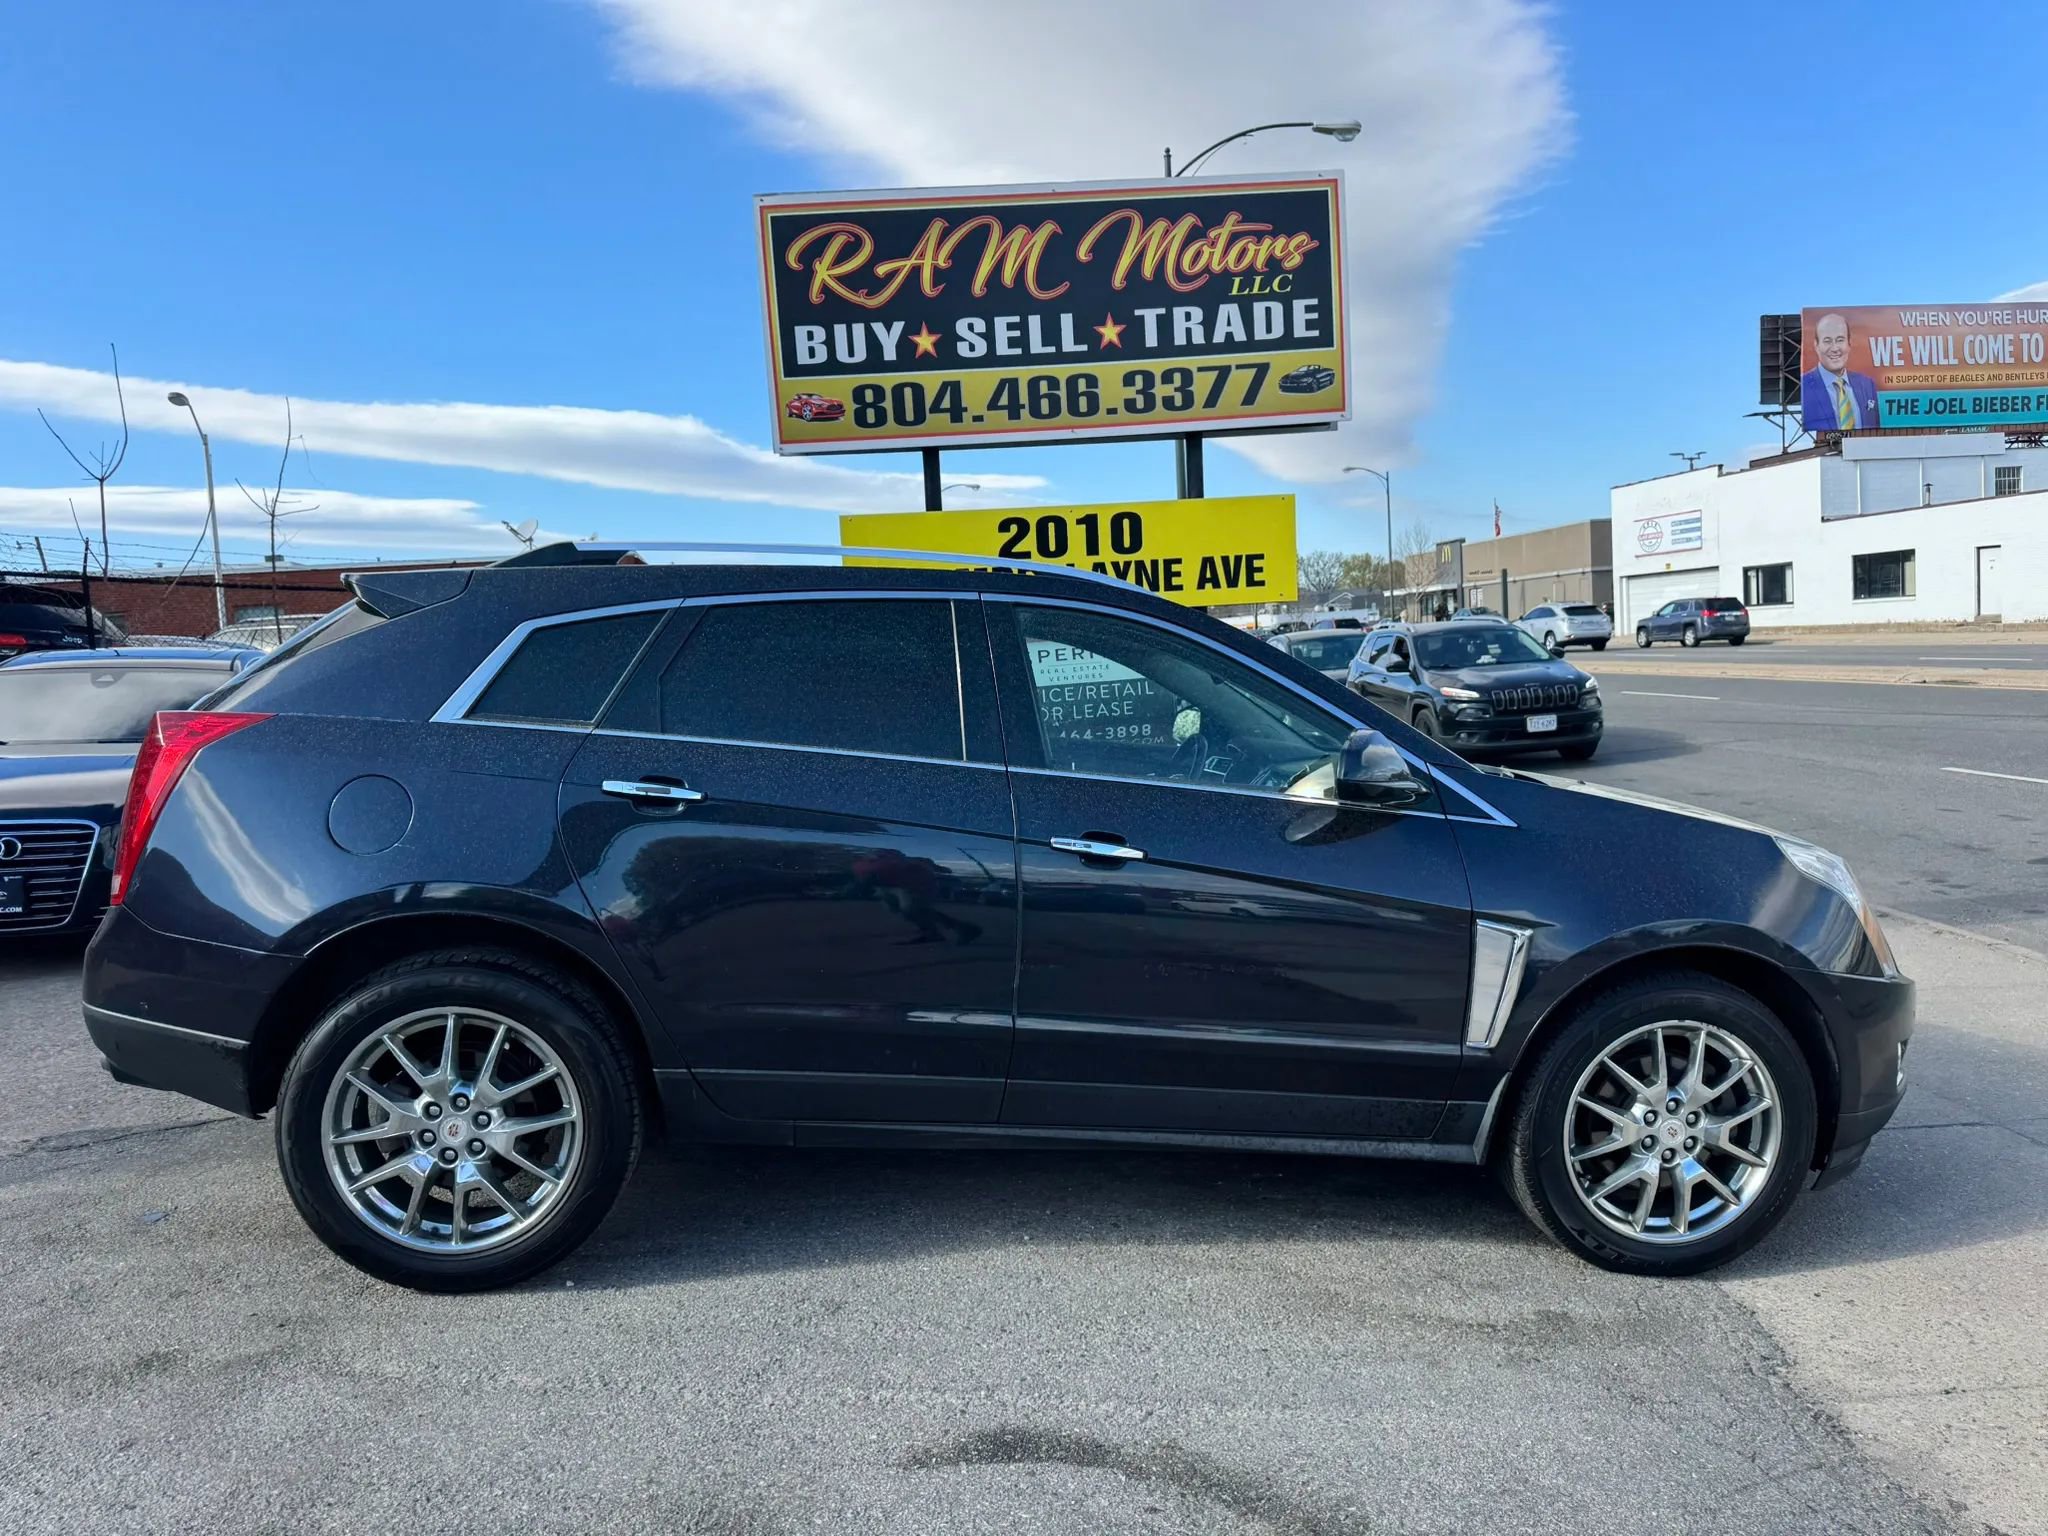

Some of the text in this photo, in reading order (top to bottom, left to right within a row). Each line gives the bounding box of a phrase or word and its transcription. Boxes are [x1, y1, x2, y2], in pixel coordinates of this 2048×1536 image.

[786, 208, 1320, 308] RAM Motors
[1228, 273, 1293, 296] LLC
[1899, 311, 1949, 327] WHEN
[1953, 310, 2012, 326] YOU'RE
[794, 298, 1320, 365] BUY SELL TRADE
[1869, 332, 2044, 367] WE WILL COME TO
[1884, 371, 2045, 384] IN SUPPORT OF BEAGLES AND BENTLEYS
[851, 362, 1271, 429] 804.466.3377
[1885, 399, 1919, 416] THE
[1924, 397, 1967, 415] JOEL
[1972, 395, 2031, 413] BIEBER
[998, 511, 1143, 560] 2010
[1196, 553, 1266, 590] AVE
[1049, 672, 1103, 682] VENTURES
[1073, 664, 1109, 673] ESTATE
[1073, 701, 1133, 719] LEASE
